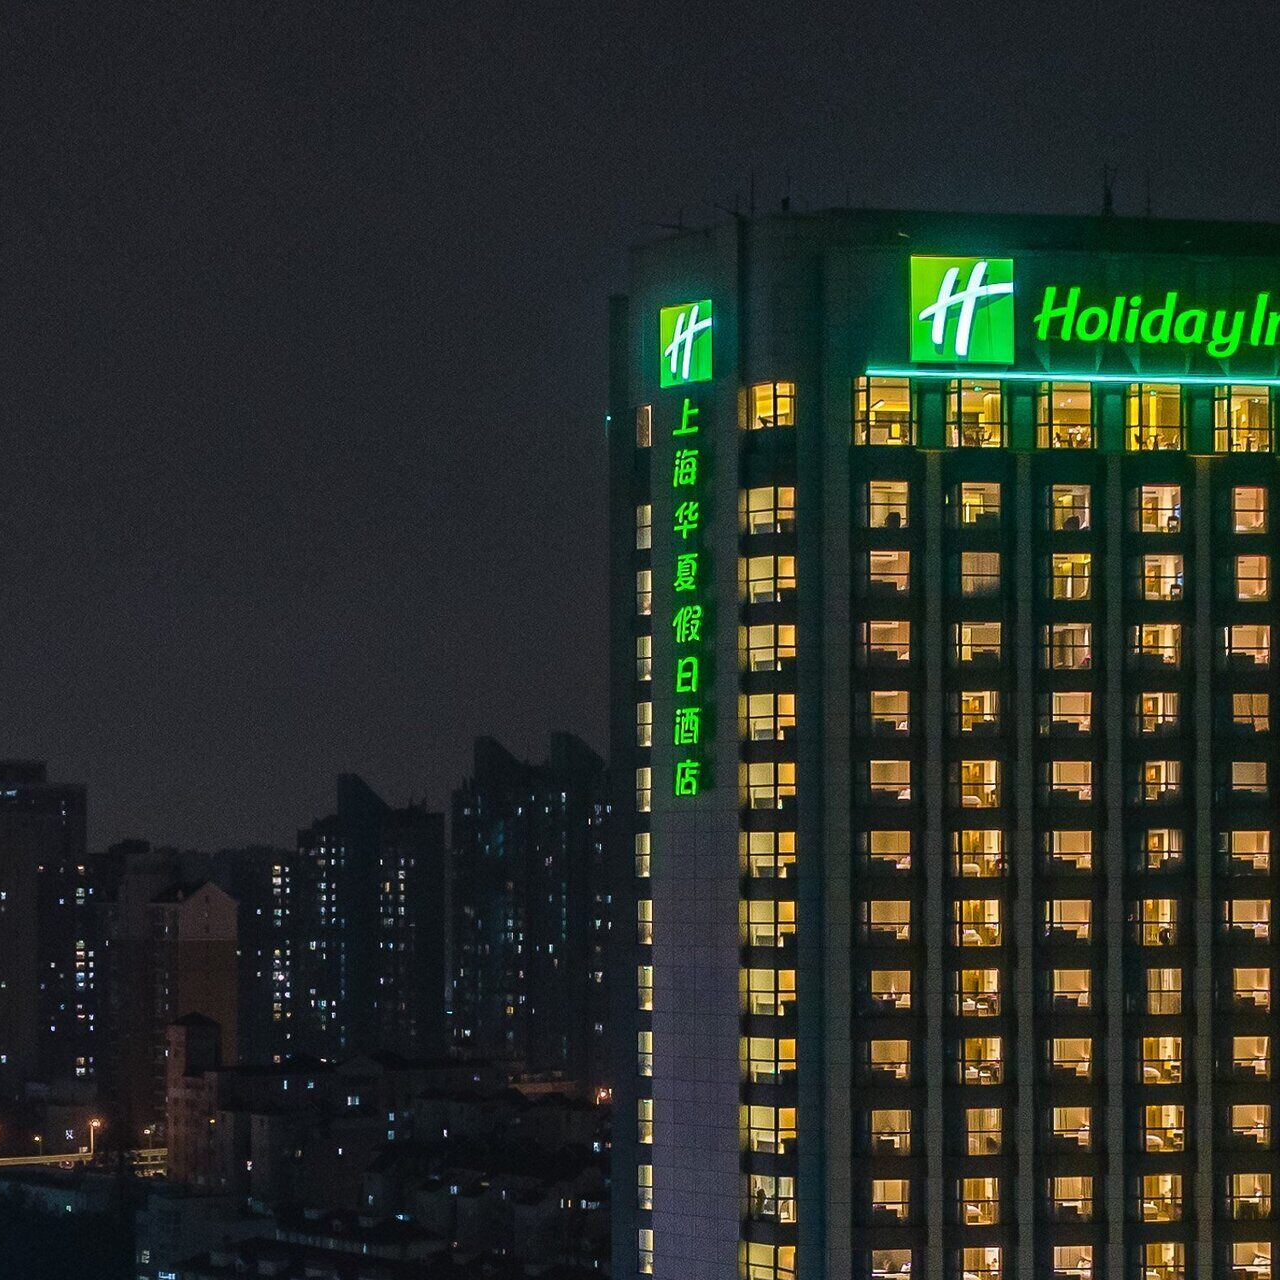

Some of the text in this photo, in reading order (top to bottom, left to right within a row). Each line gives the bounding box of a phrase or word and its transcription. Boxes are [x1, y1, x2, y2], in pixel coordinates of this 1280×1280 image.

[1034, 287, 1245, 358] Holiday
[672, 398, 703, 796] 上海华夏假日酒店
